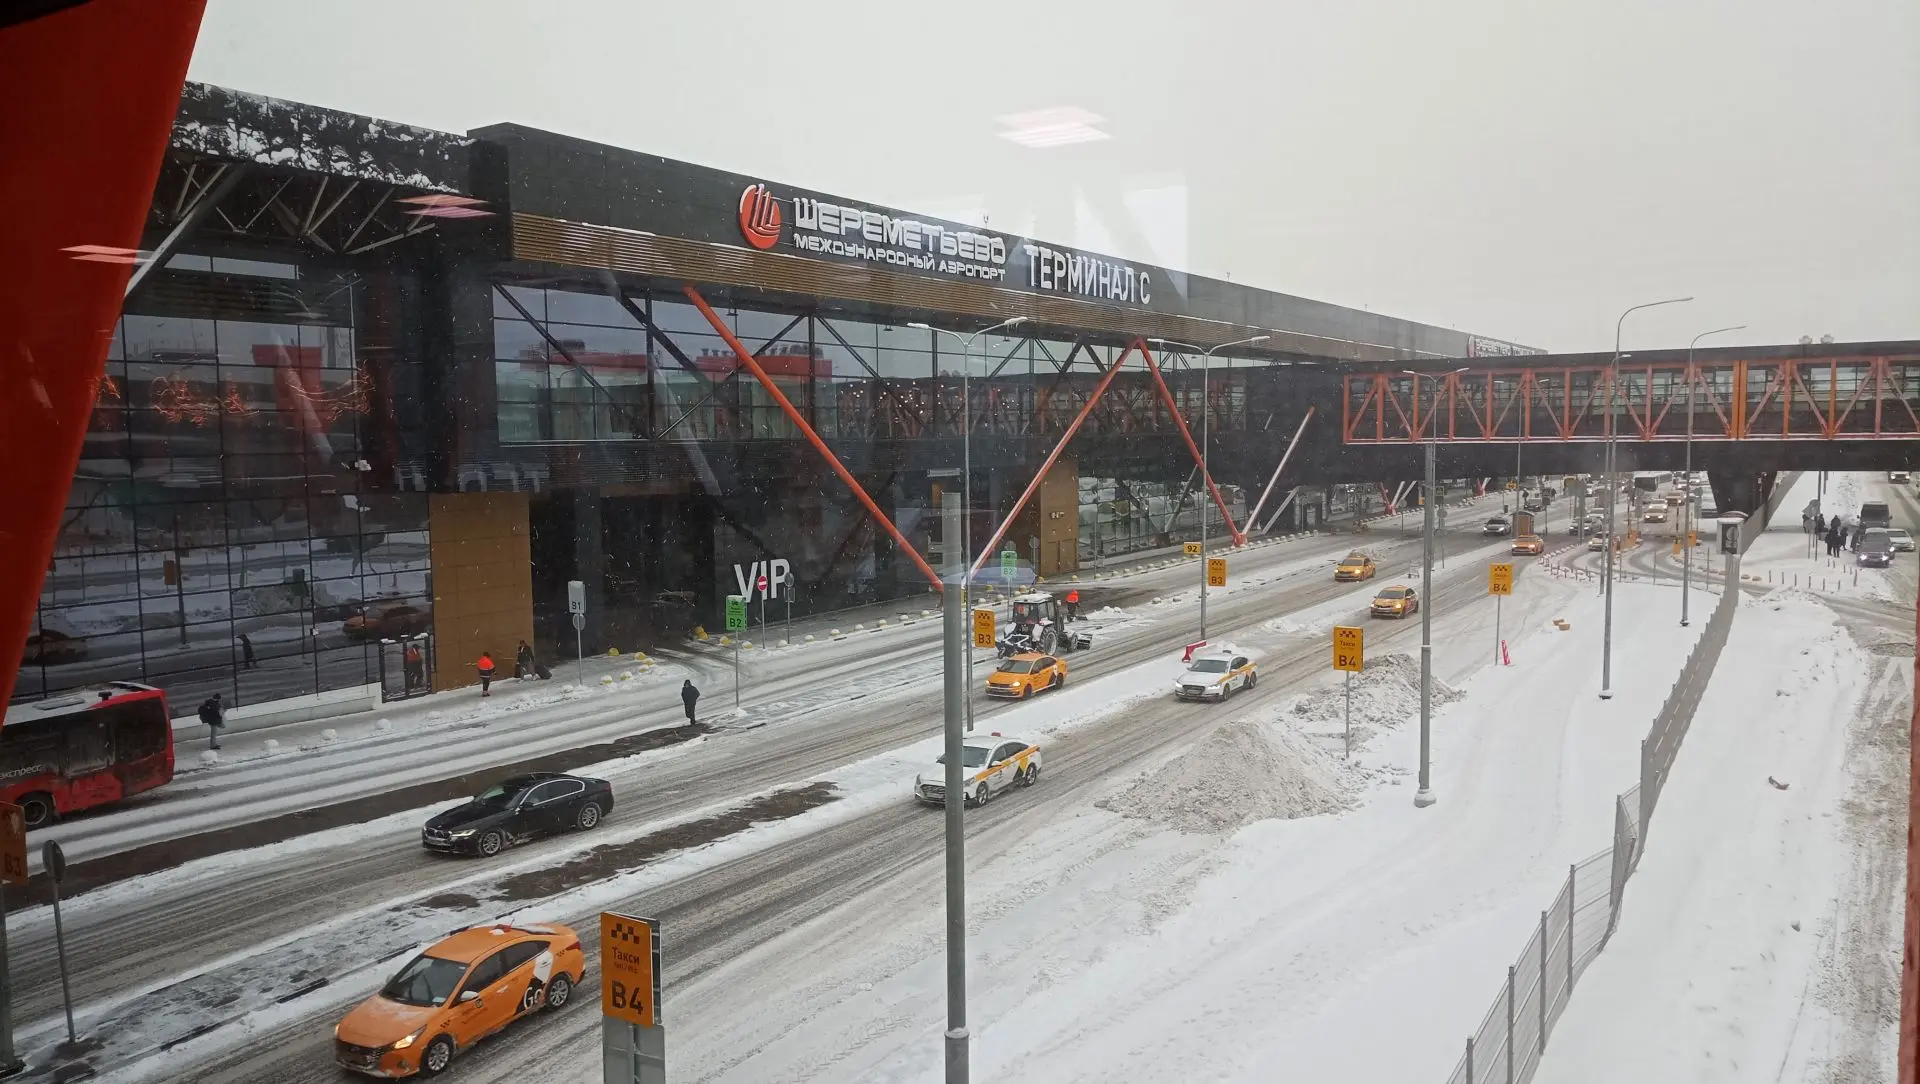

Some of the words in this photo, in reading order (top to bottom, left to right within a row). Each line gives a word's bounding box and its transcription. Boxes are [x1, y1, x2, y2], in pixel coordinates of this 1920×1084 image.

[793, 197, 1006, 265] ШЕРЕМЕТЬЕВО
[793, 233, 936, 271] МЕЖДУНАРОДНЫЙ
[938, 260, 1006, 282] АЭРОПОРТ
[1023, 244, 1135, 303] ТЕРМИНАЛ
[1187, 545, 1198, 553] 92
[733, 558, 790, 603] VIP
[611, 946, 640, 965] Такси
